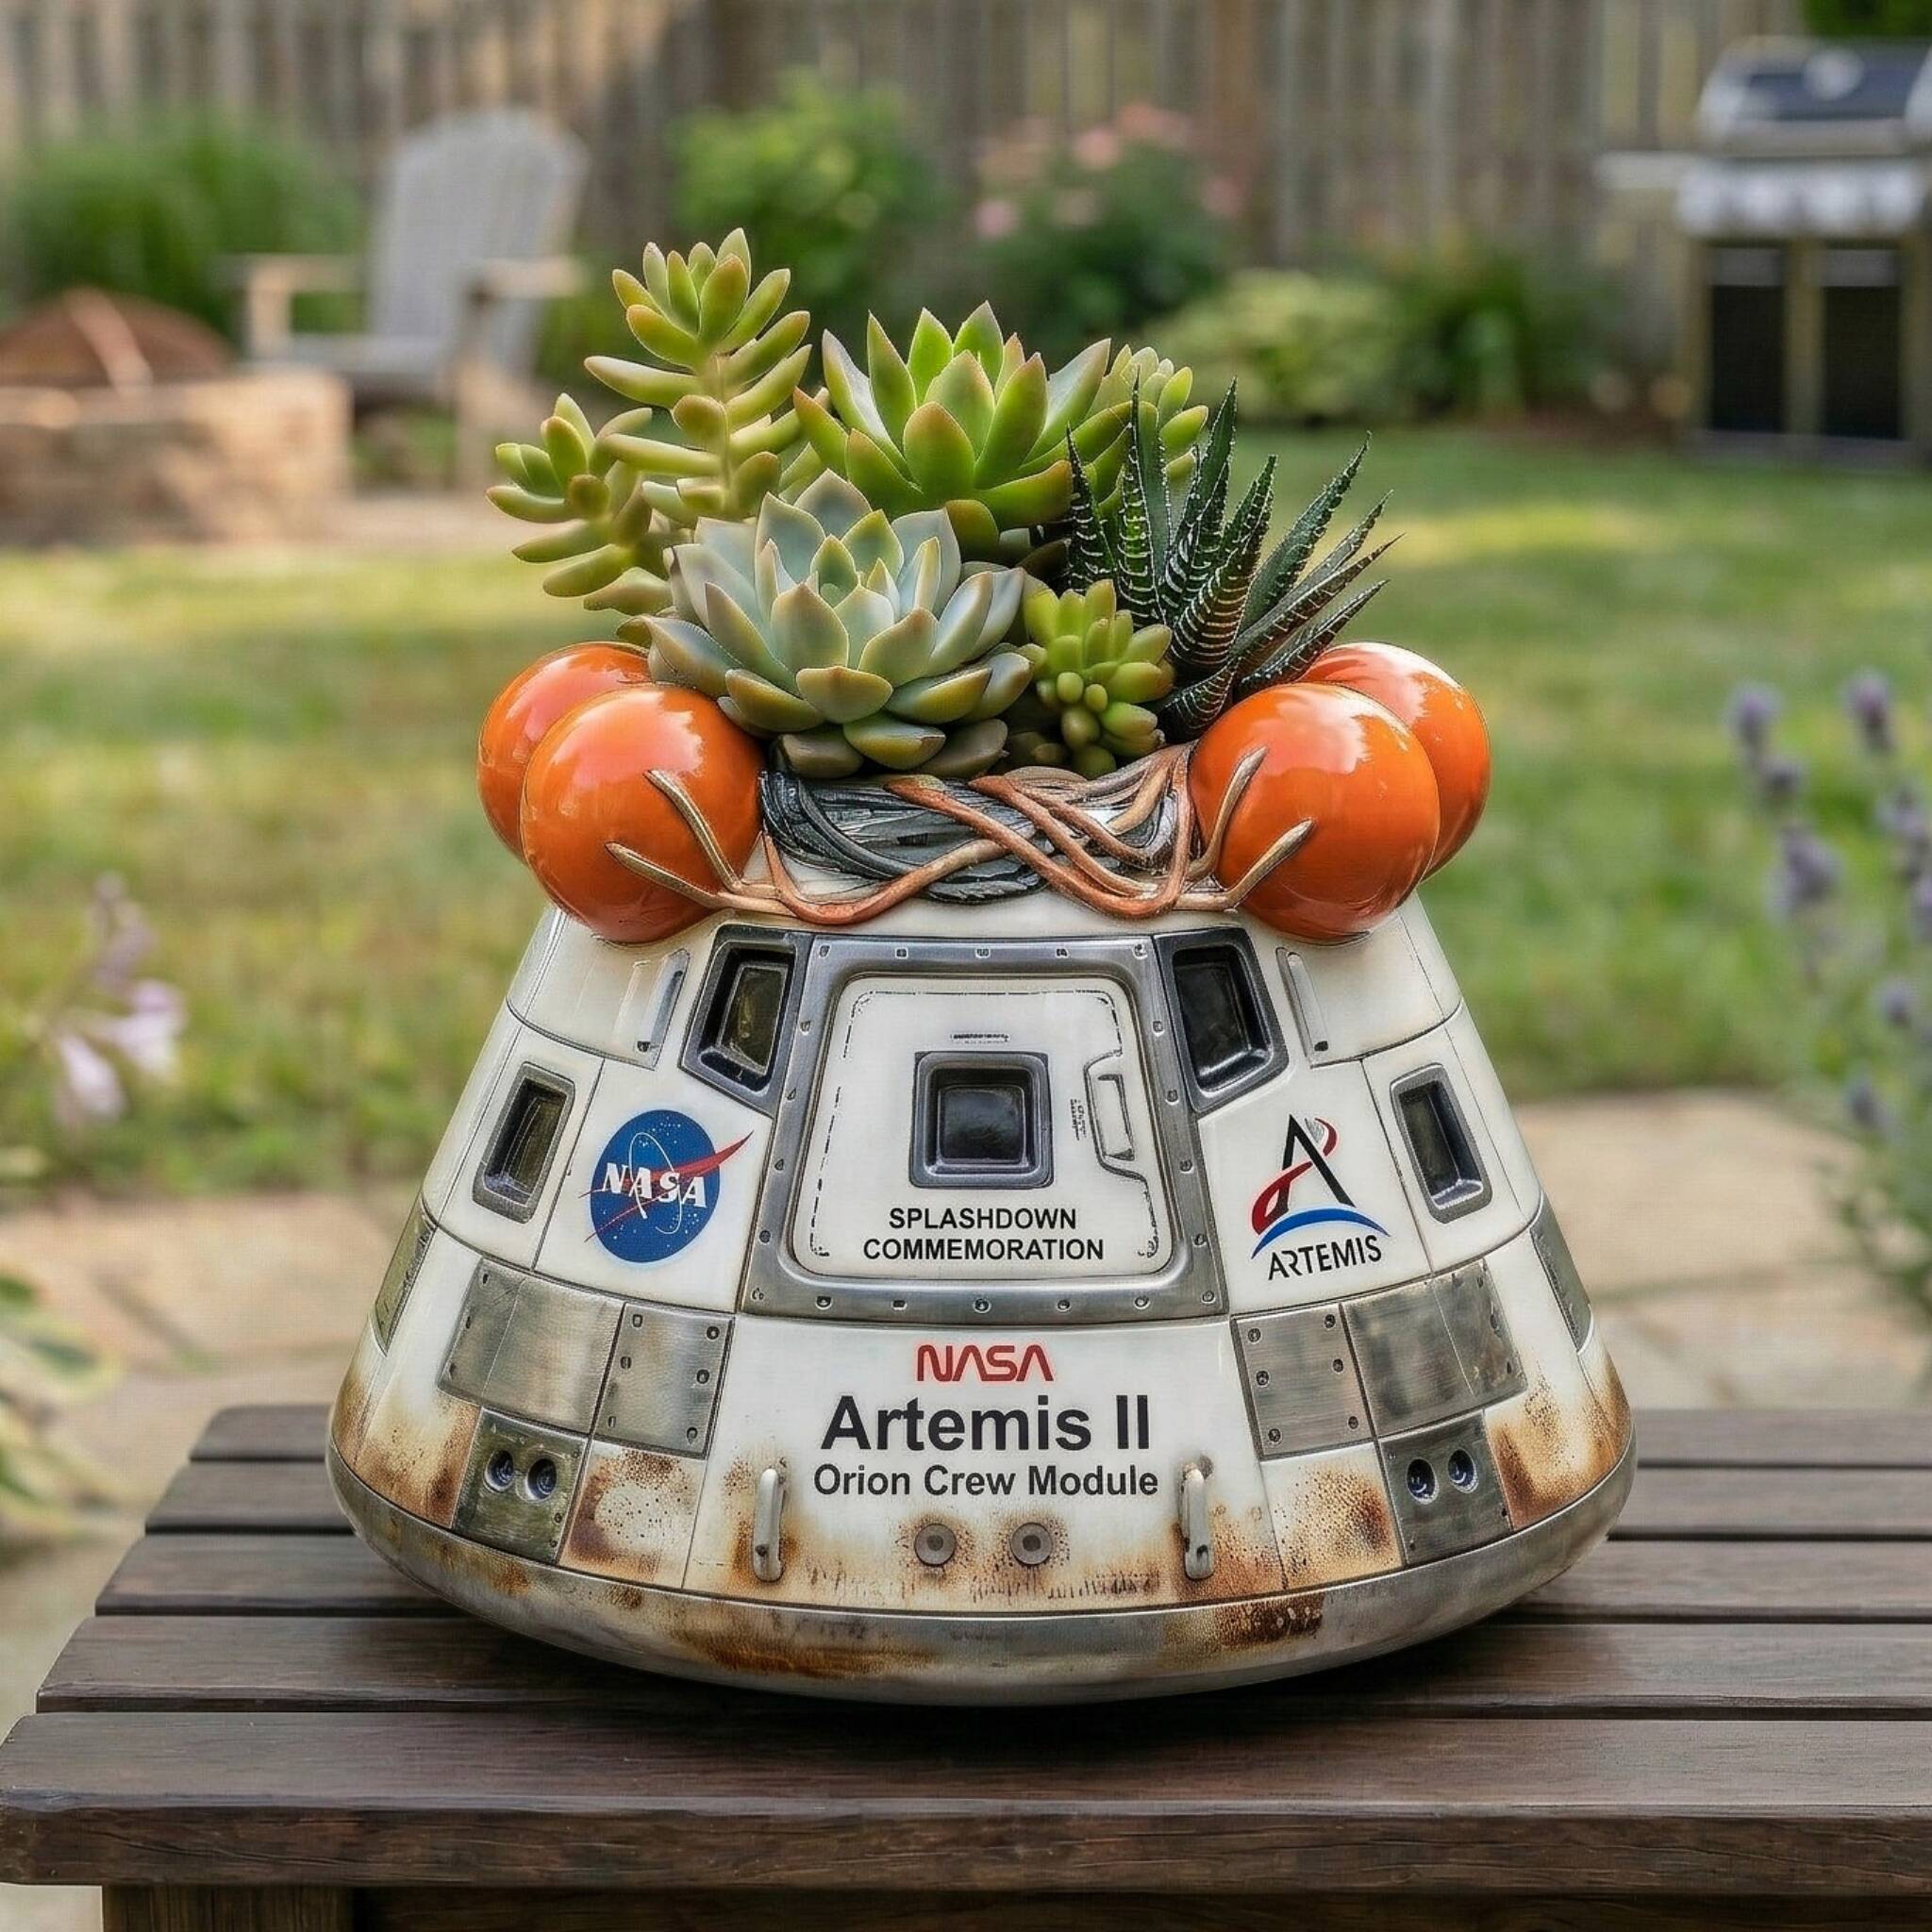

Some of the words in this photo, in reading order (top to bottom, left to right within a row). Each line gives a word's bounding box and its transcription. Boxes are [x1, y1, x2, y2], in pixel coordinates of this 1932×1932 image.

[602, 1162, 707, 1208] NASA
[889, 1208, 1076, 1229] SPLASHDOWN
[863, 1239, 1104, 1260] COMMEMORATION
[1268, 1234, 1382, 1280] ARTEMIS
[916, 1343, 1054, 1382] NASA
[821, 1394, 1091, 1451] Artemis
[1116, 1394, 1150, 1450] II
[814, 1463, 910, 1495] Orion
[924, 1463, 1017, 1495] Crew
[1029, 1463, 1158, 1495] Module
